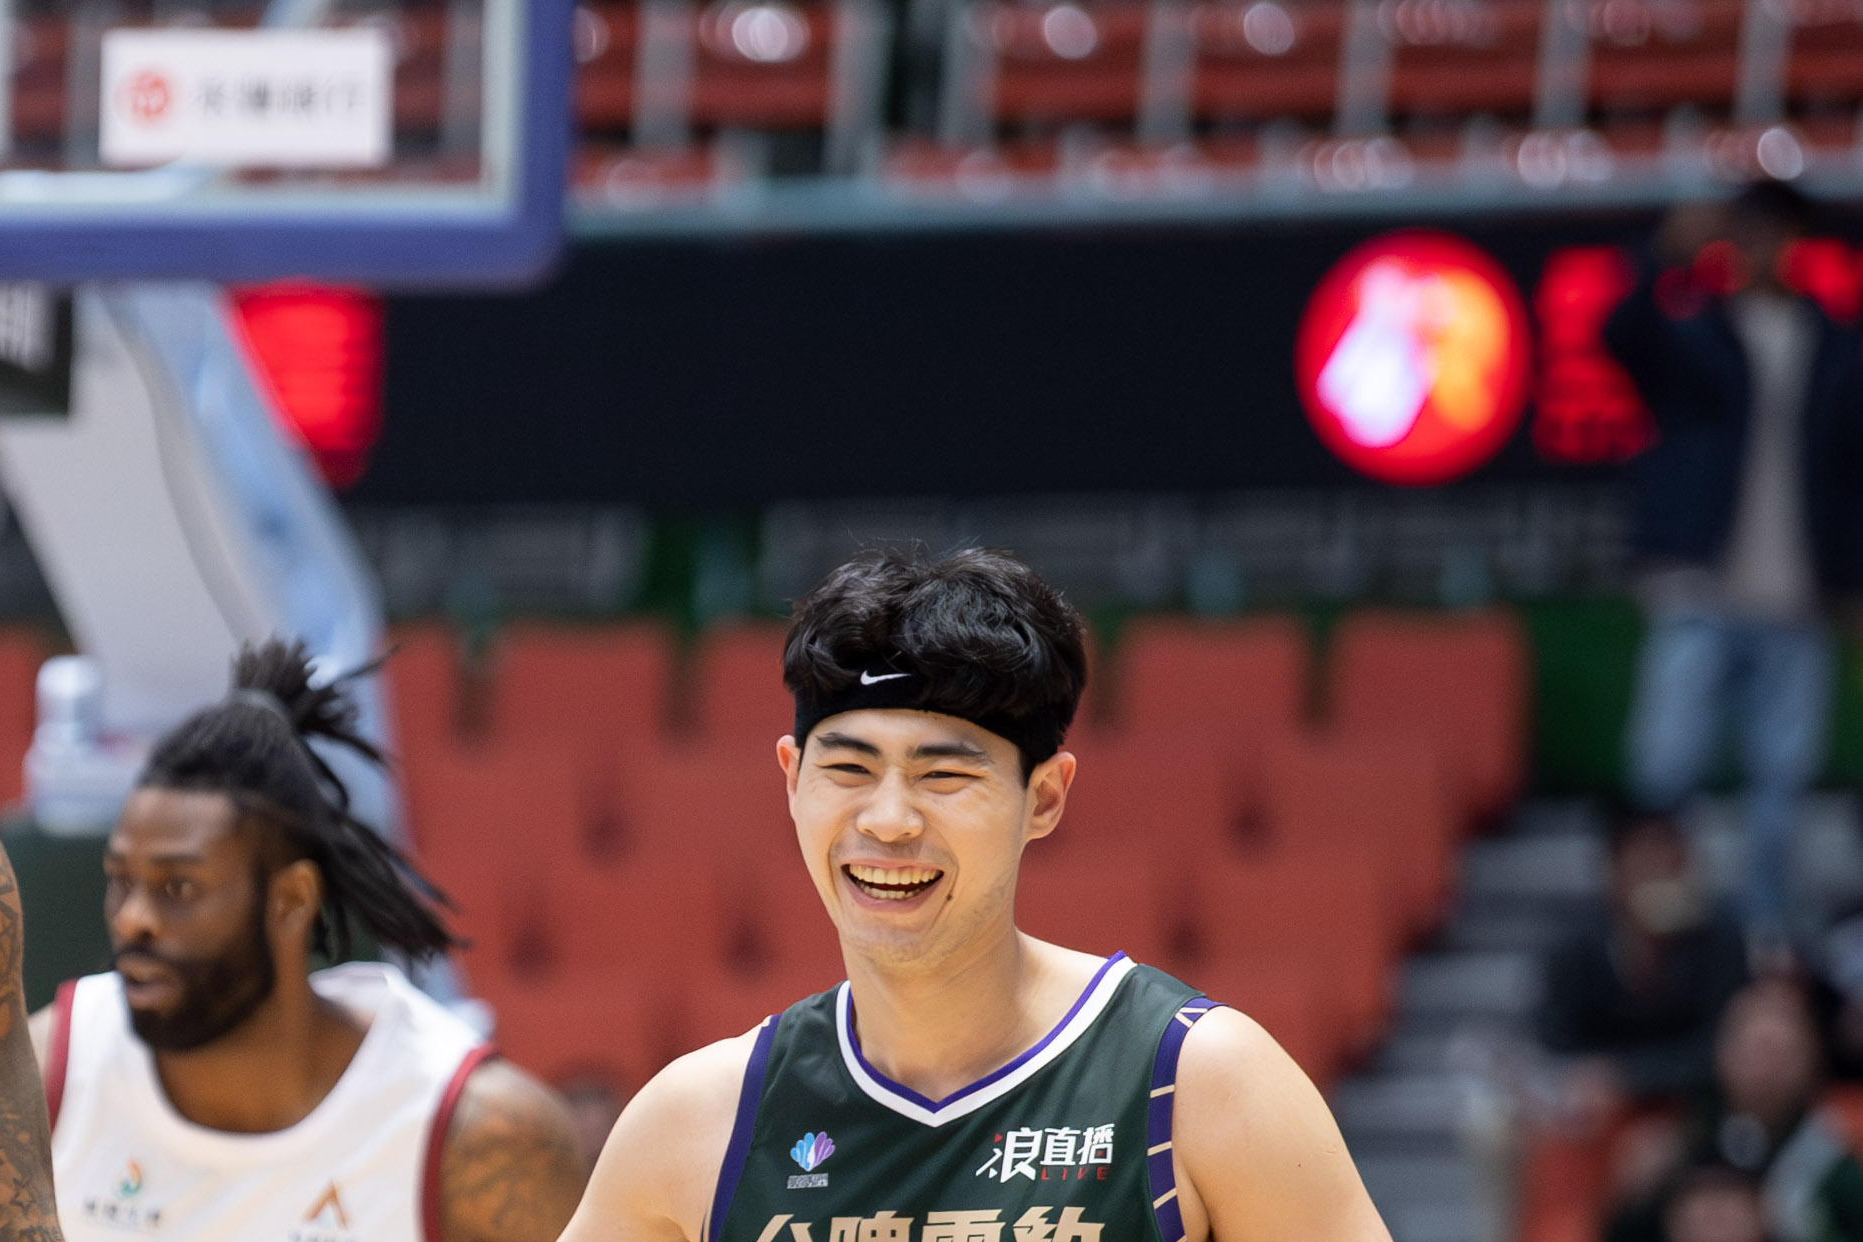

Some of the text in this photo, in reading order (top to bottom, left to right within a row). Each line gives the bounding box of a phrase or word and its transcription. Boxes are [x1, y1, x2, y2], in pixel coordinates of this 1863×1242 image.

[975, 1123, 1115, 1183] 浪直播
[1040, 1166, 1108, 1181] LIVE
